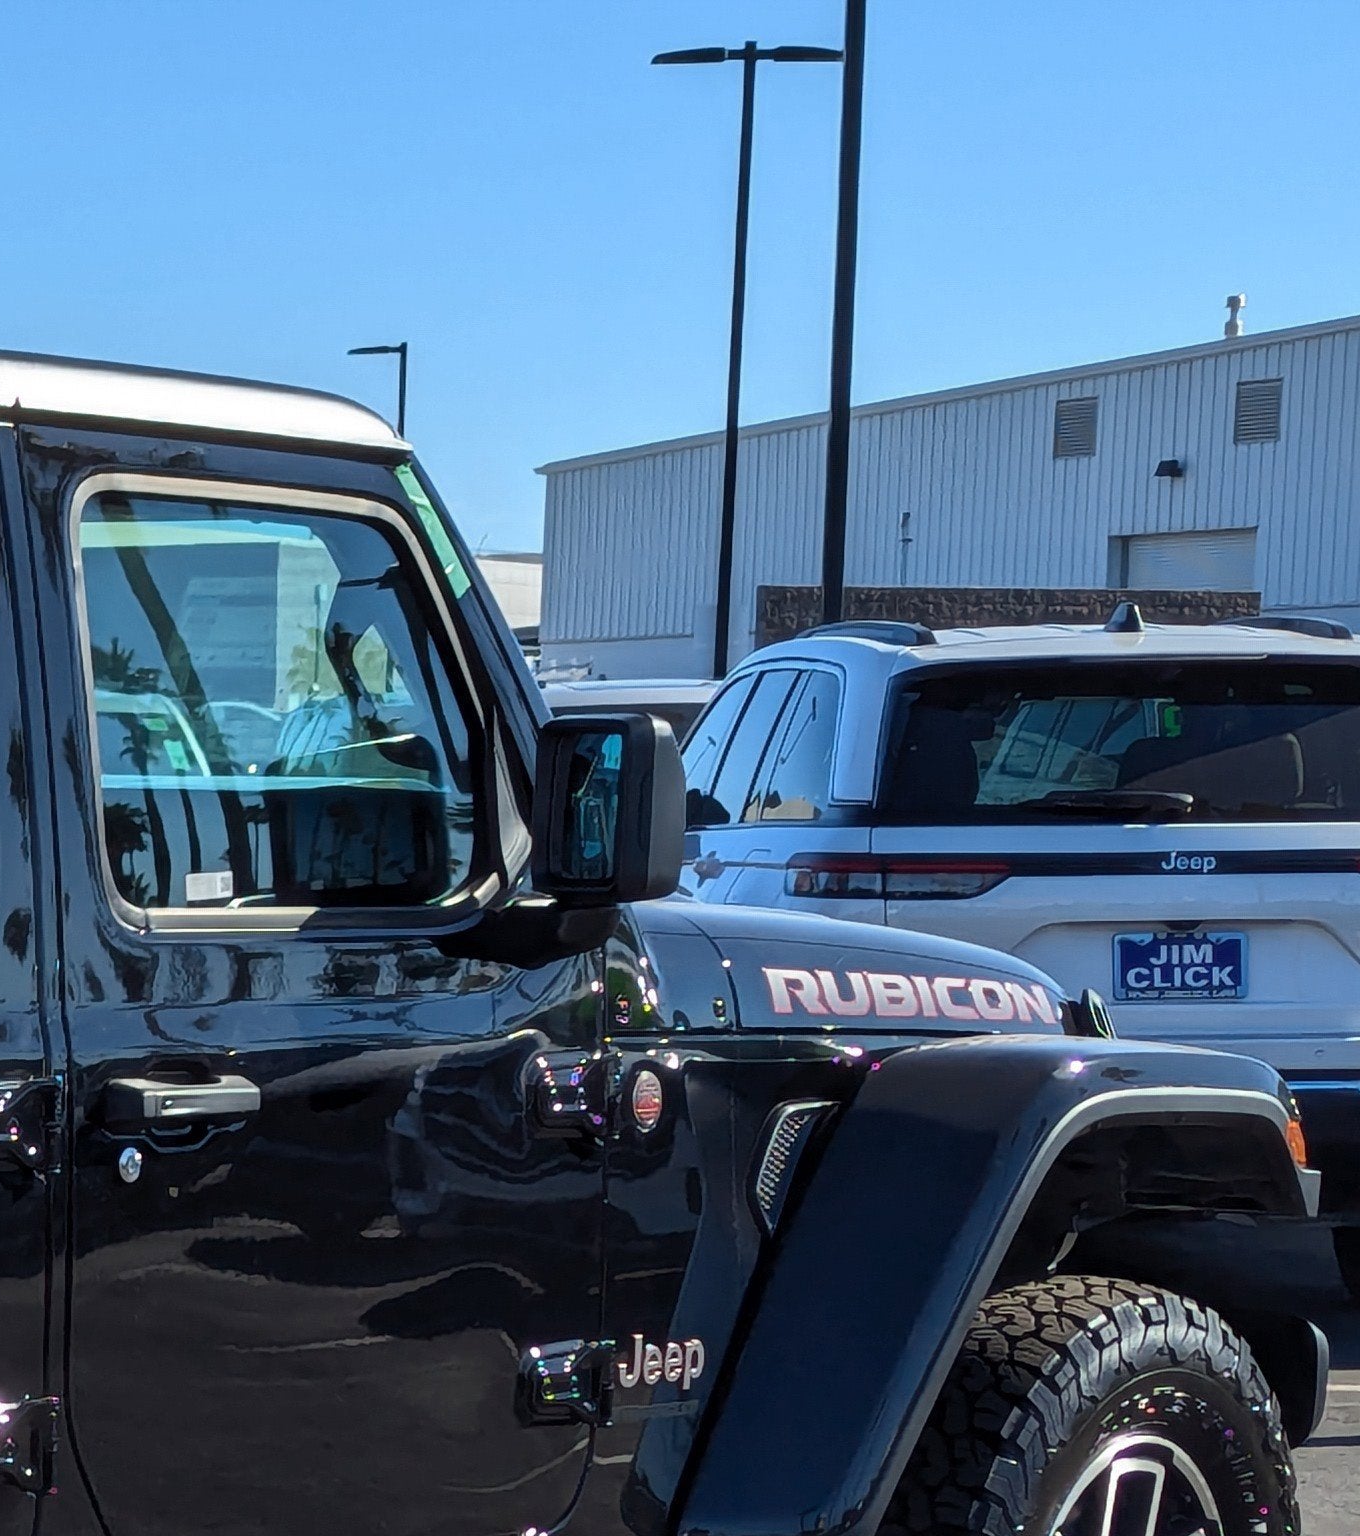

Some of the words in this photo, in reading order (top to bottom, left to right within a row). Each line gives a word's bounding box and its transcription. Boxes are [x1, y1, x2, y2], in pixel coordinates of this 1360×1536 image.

[1161, 851, 1217, 873] Jeep
[1148, 943, 1214, 966] JIM
[1126, 965, 1235, 988] CLICK
[761, 966, 1057, 1024] RUBICON
[618, 1333, 705, 1390] Jeep
